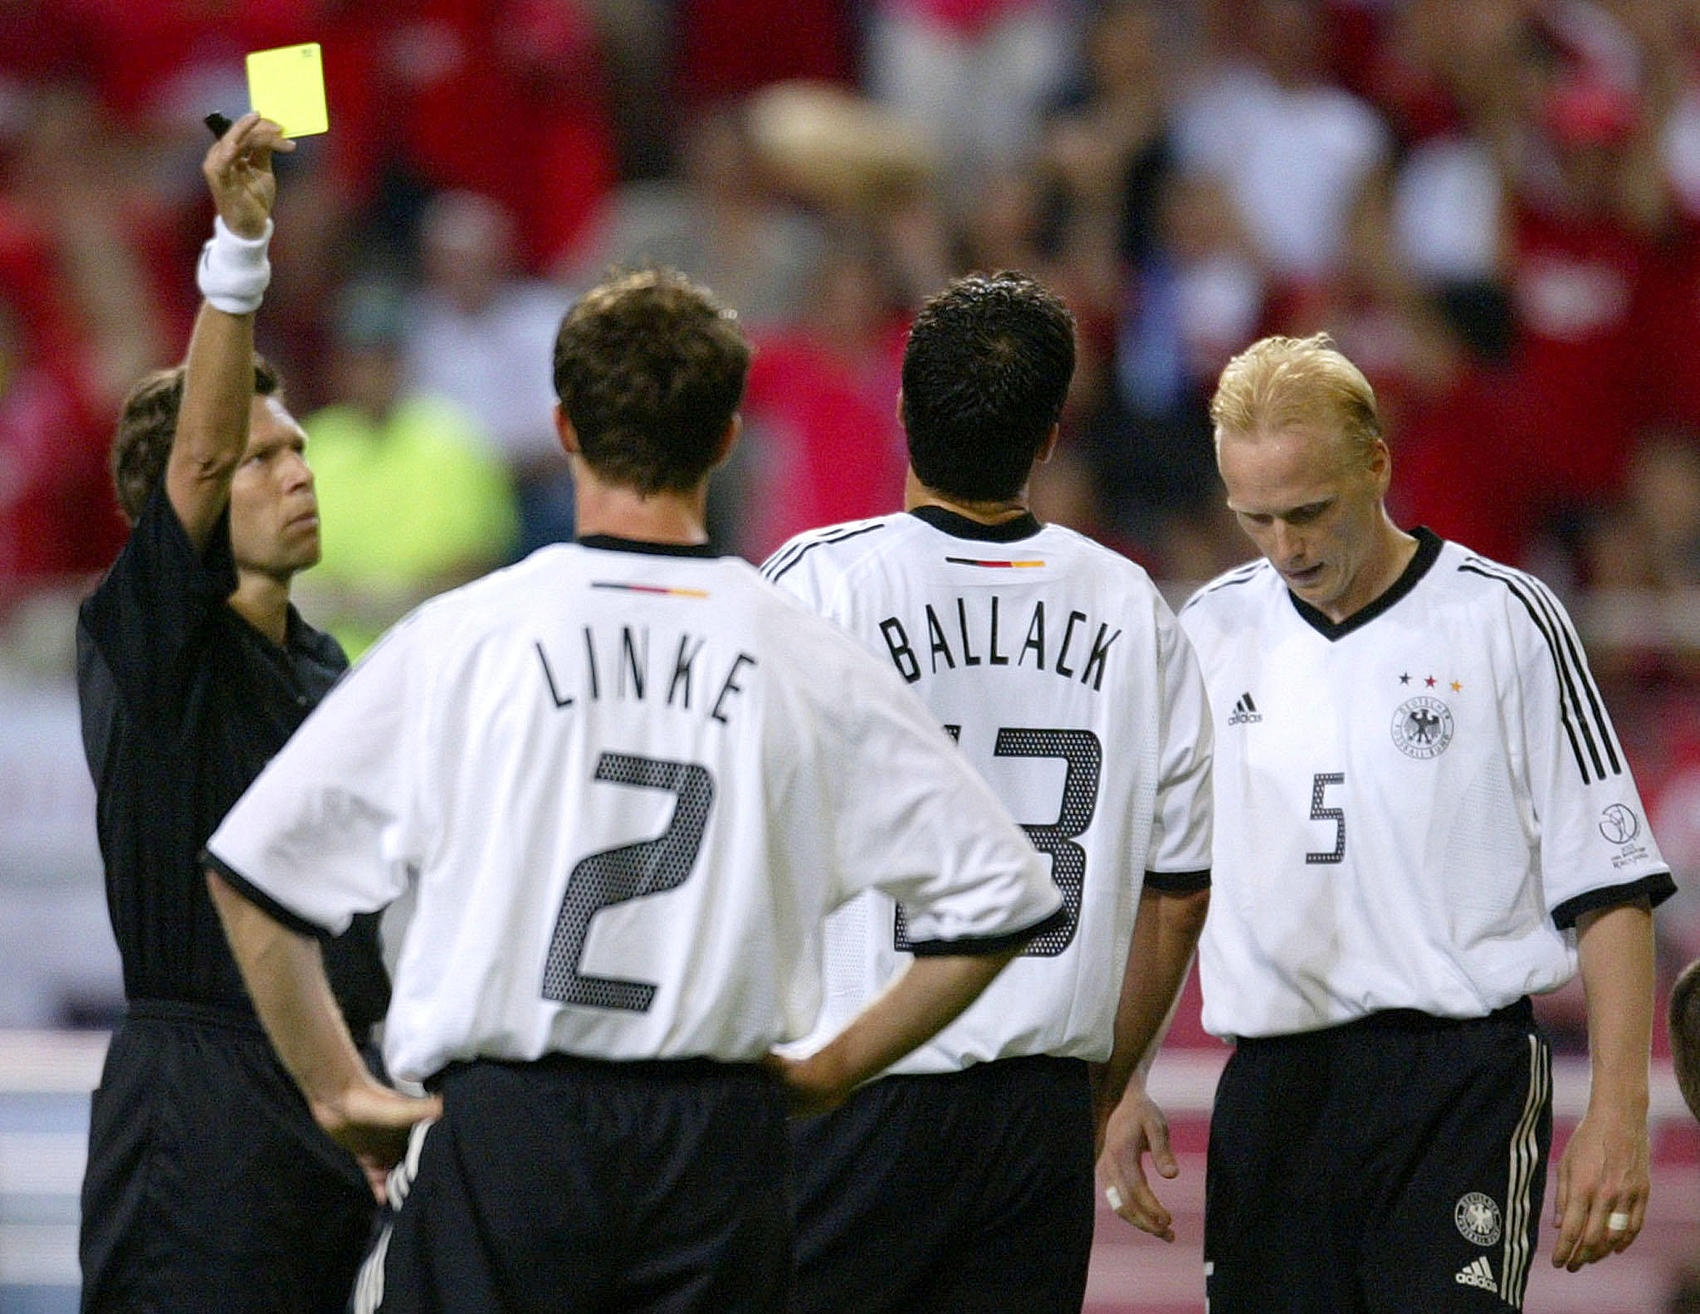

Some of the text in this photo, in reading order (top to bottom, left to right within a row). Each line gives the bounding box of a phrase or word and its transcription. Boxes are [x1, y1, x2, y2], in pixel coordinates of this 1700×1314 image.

[535, 625, 757, 724] LINKE
[878, 596, 1123, 692] BALLACK
[893, 724, 1103, 957] 3
[1305, 772, 1346, 865] 5
[540, 751, 714, 1013] 2
[1455, 1272, 1498, 1293] adidas
